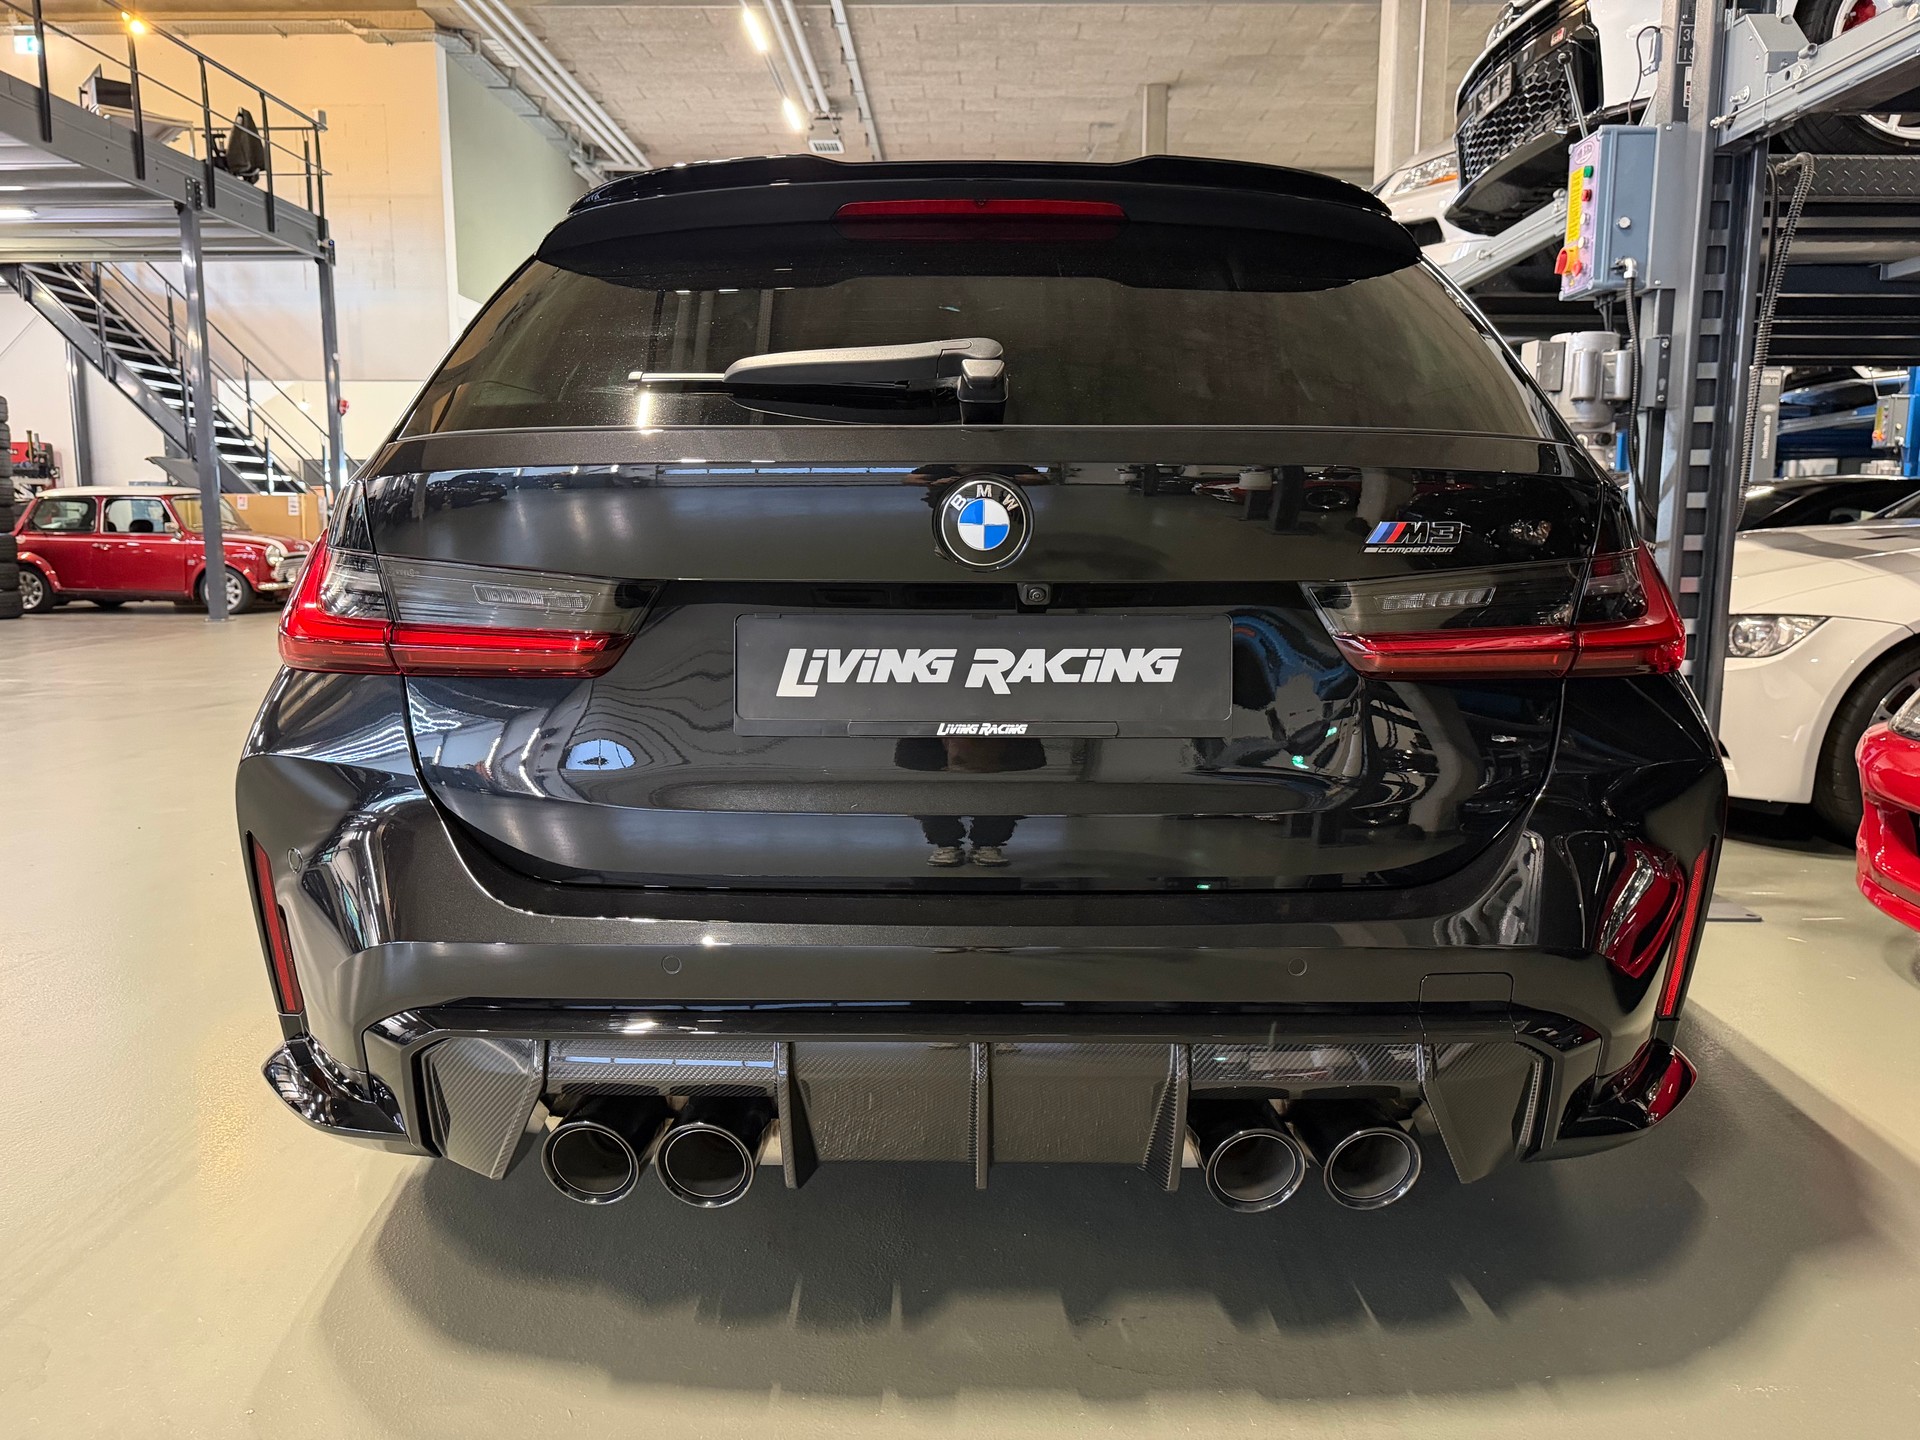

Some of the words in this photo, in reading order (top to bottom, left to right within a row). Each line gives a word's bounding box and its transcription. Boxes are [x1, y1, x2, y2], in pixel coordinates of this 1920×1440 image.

[950, 484, 1019, 511] BMW
[1393, 521, 1463, 544] M3
[1378, 545, 1455, 554] competition
